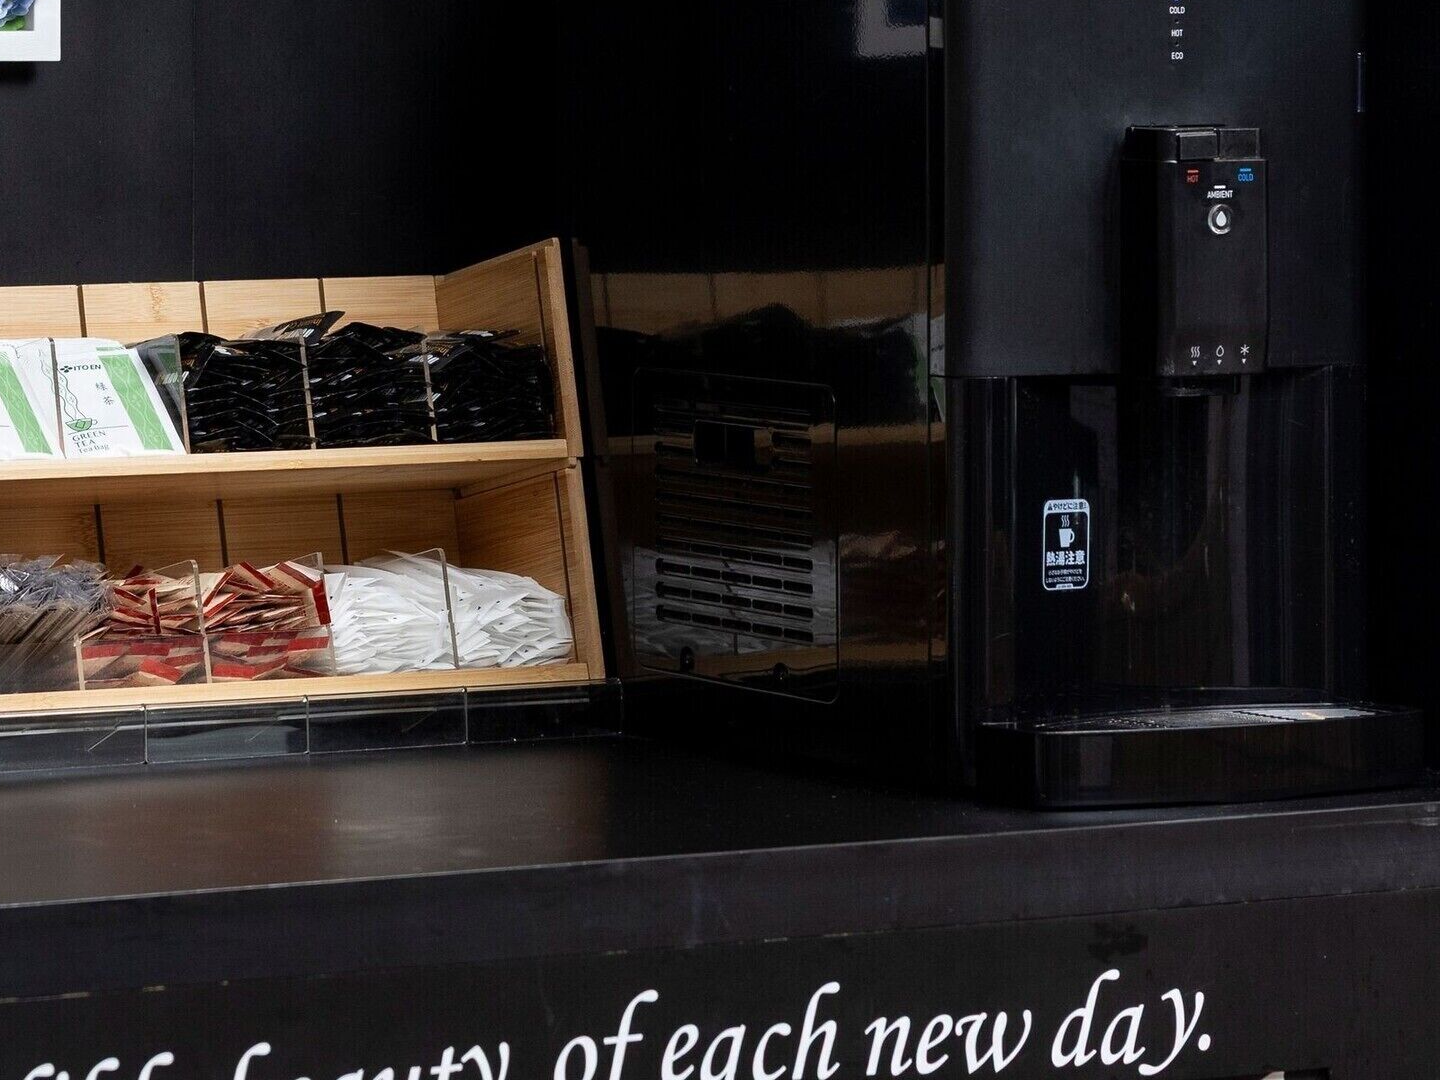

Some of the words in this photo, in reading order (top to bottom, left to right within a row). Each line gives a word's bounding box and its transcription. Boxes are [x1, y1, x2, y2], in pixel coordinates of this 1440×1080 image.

[1169, 6, 1186, 15] COLD
[1171, 29, 1183, 37] HOT
[1171, 51, 1184, 60] ECO
[1187, 174, 1199, 183] HOT
[1238, 173, 1254, 182] COLD
[1206, 190, 1233, 199] AMBIENT
[72, 431, 106, 442] GREEN
[76, 439, 96, 448] TEA
[1046, 549, 1086, 567] 熱湯注意
[553, 988, 659, 1080] of
[661, 981, 841, 1080] each
[864, 1009, 1033, 1077] new
[1051, 968, 1212, 1076] day.
